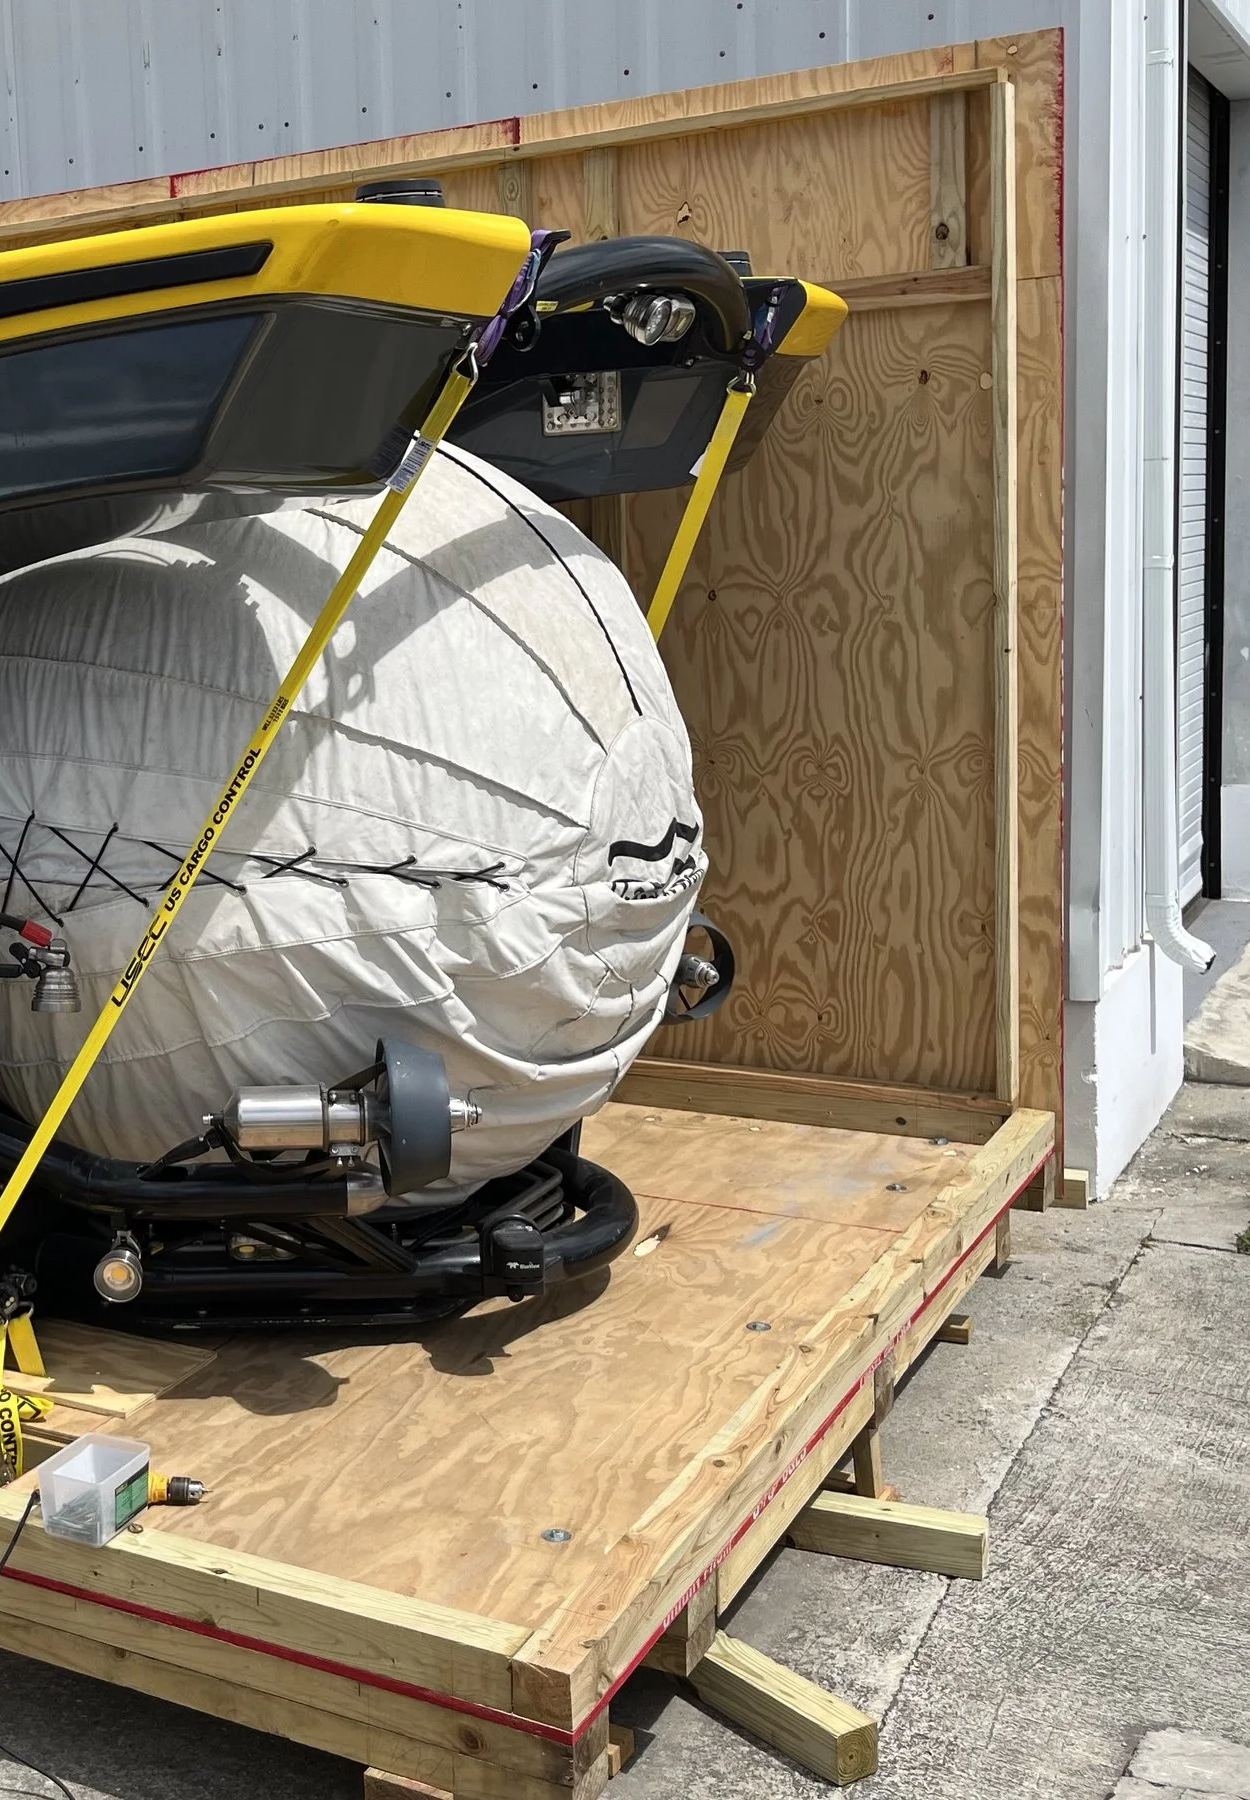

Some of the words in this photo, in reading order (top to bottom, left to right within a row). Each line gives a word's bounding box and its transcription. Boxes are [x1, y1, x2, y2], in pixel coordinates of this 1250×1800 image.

[164, 887, 181, 911] US
[180, 828, 215, 885] CARGO
[213, 748, 262, 824] CONTROL
